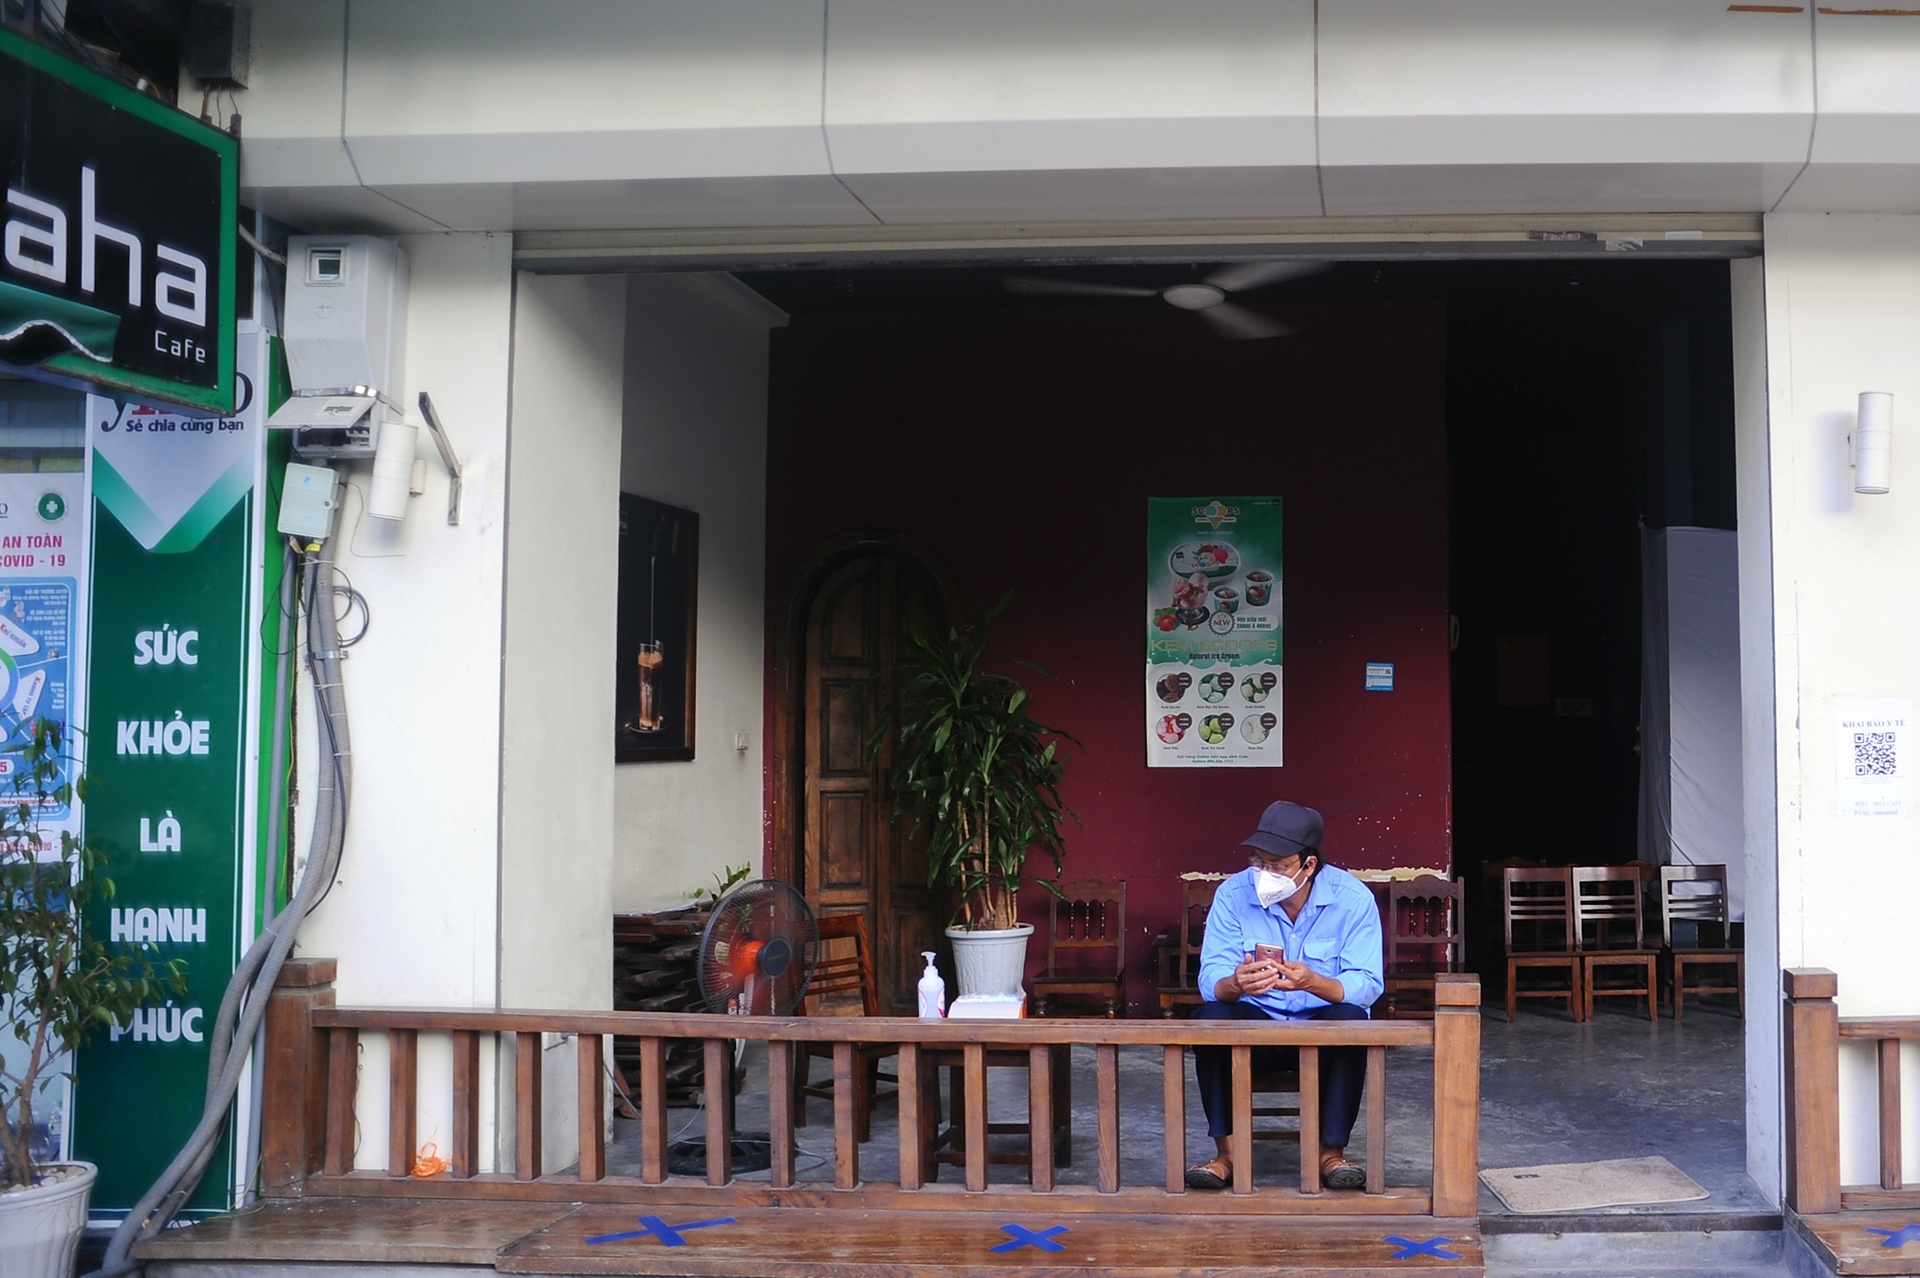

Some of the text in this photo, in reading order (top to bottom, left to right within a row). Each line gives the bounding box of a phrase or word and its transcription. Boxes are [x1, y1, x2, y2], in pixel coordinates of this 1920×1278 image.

[4, 166, 207, 327] aha
[154, 330, 206, 363] Cafe
[148, 419, 175, 432] chia
[218, 418, 244, 434] bạn
[2, 533, 63, 549] AN TOÀN
[50, 554, 66, 567] 19
[1213, 619, 1231, 627] NEW
[134, 623, 199, 665] SỨC
[1150, 639, 1278, 652] KEM SCOOPS
[116, 710, 210, 755] KHỎE
[140, 810, 181, 852] LÀ
[110, 907, 206, 951] HẠNH
